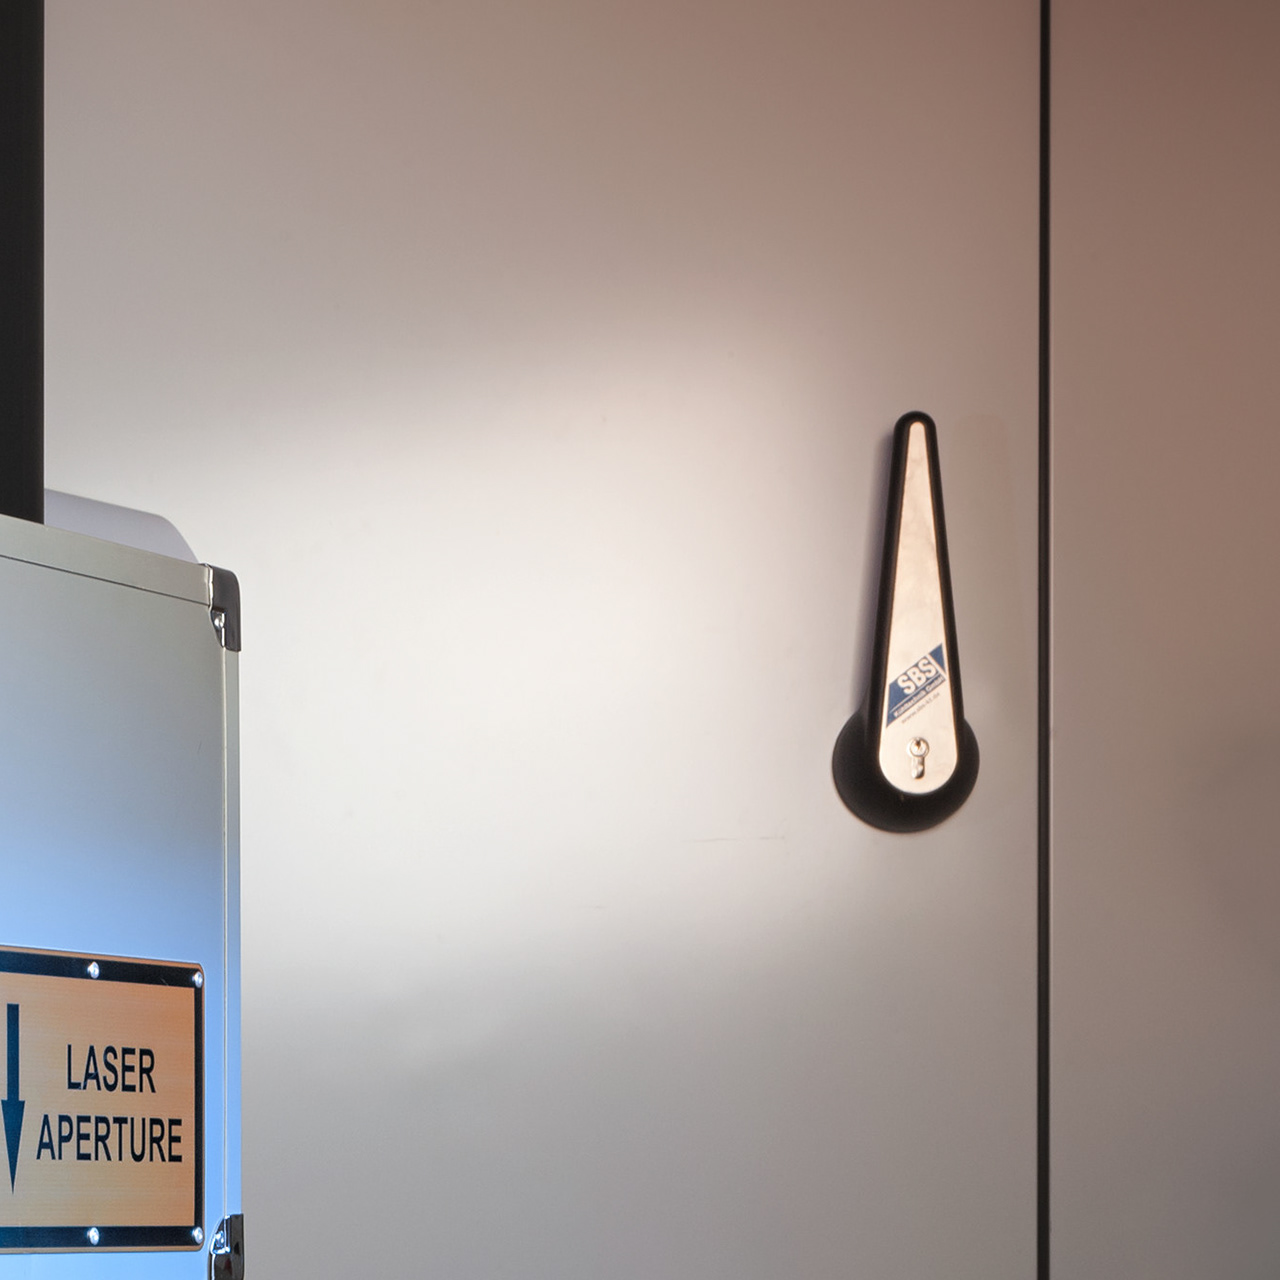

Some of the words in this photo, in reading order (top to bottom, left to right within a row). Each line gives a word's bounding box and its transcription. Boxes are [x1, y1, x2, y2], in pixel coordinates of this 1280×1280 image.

[897, 658, 937, 695] SBS
[67, 1044, 157, 1094] LASER
[36, 1114, 183, 1163] APERTURE
